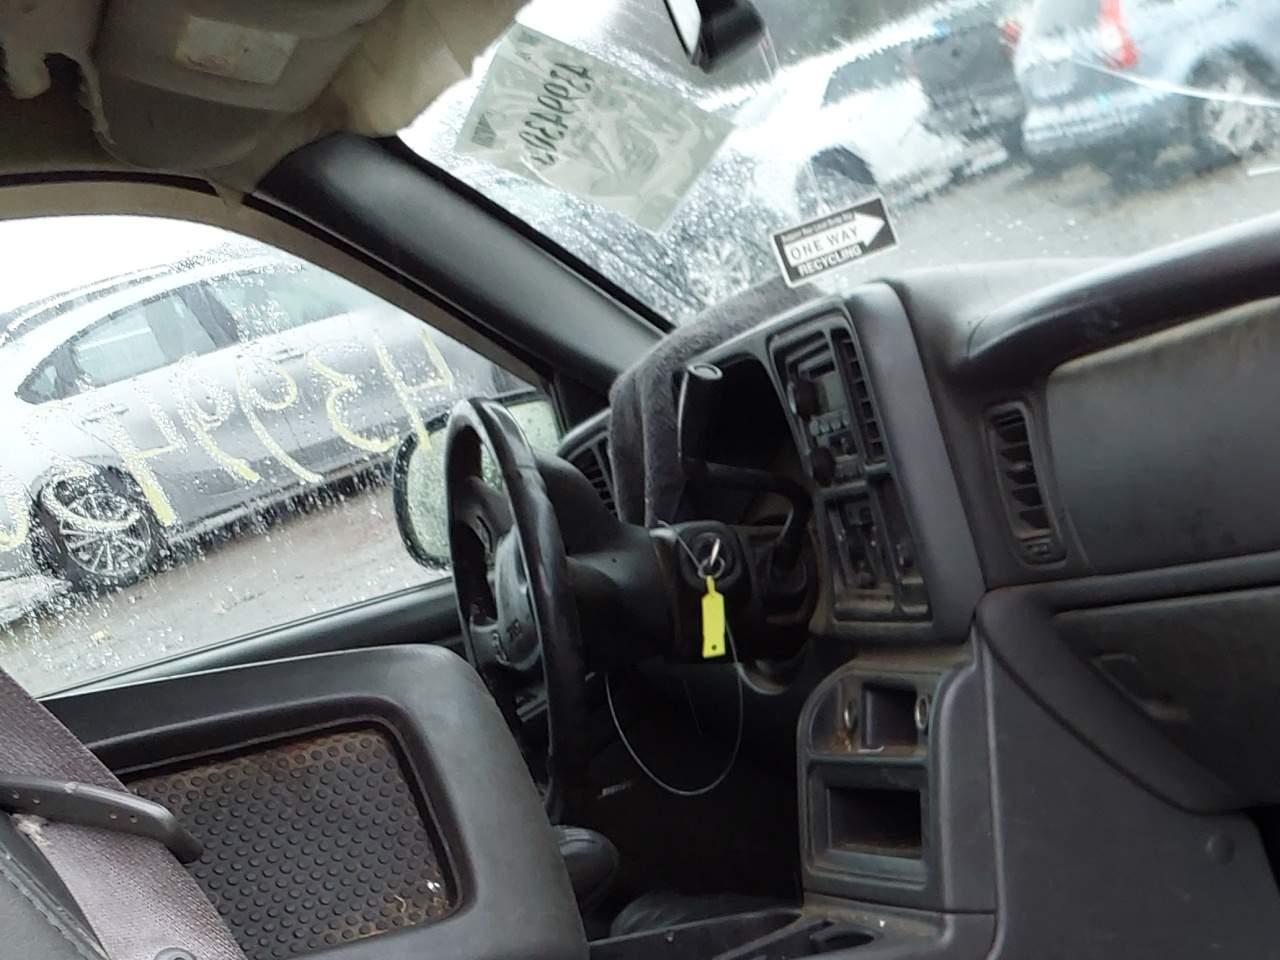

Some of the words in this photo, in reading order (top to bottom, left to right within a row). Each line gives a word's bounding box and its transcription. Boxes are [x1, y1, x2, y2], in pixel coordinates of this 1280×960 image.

[789, 237, 824, 260] ONE
[826, 225, 859, 247] WAY
[797, 244, 863, 277] RECYCLING
